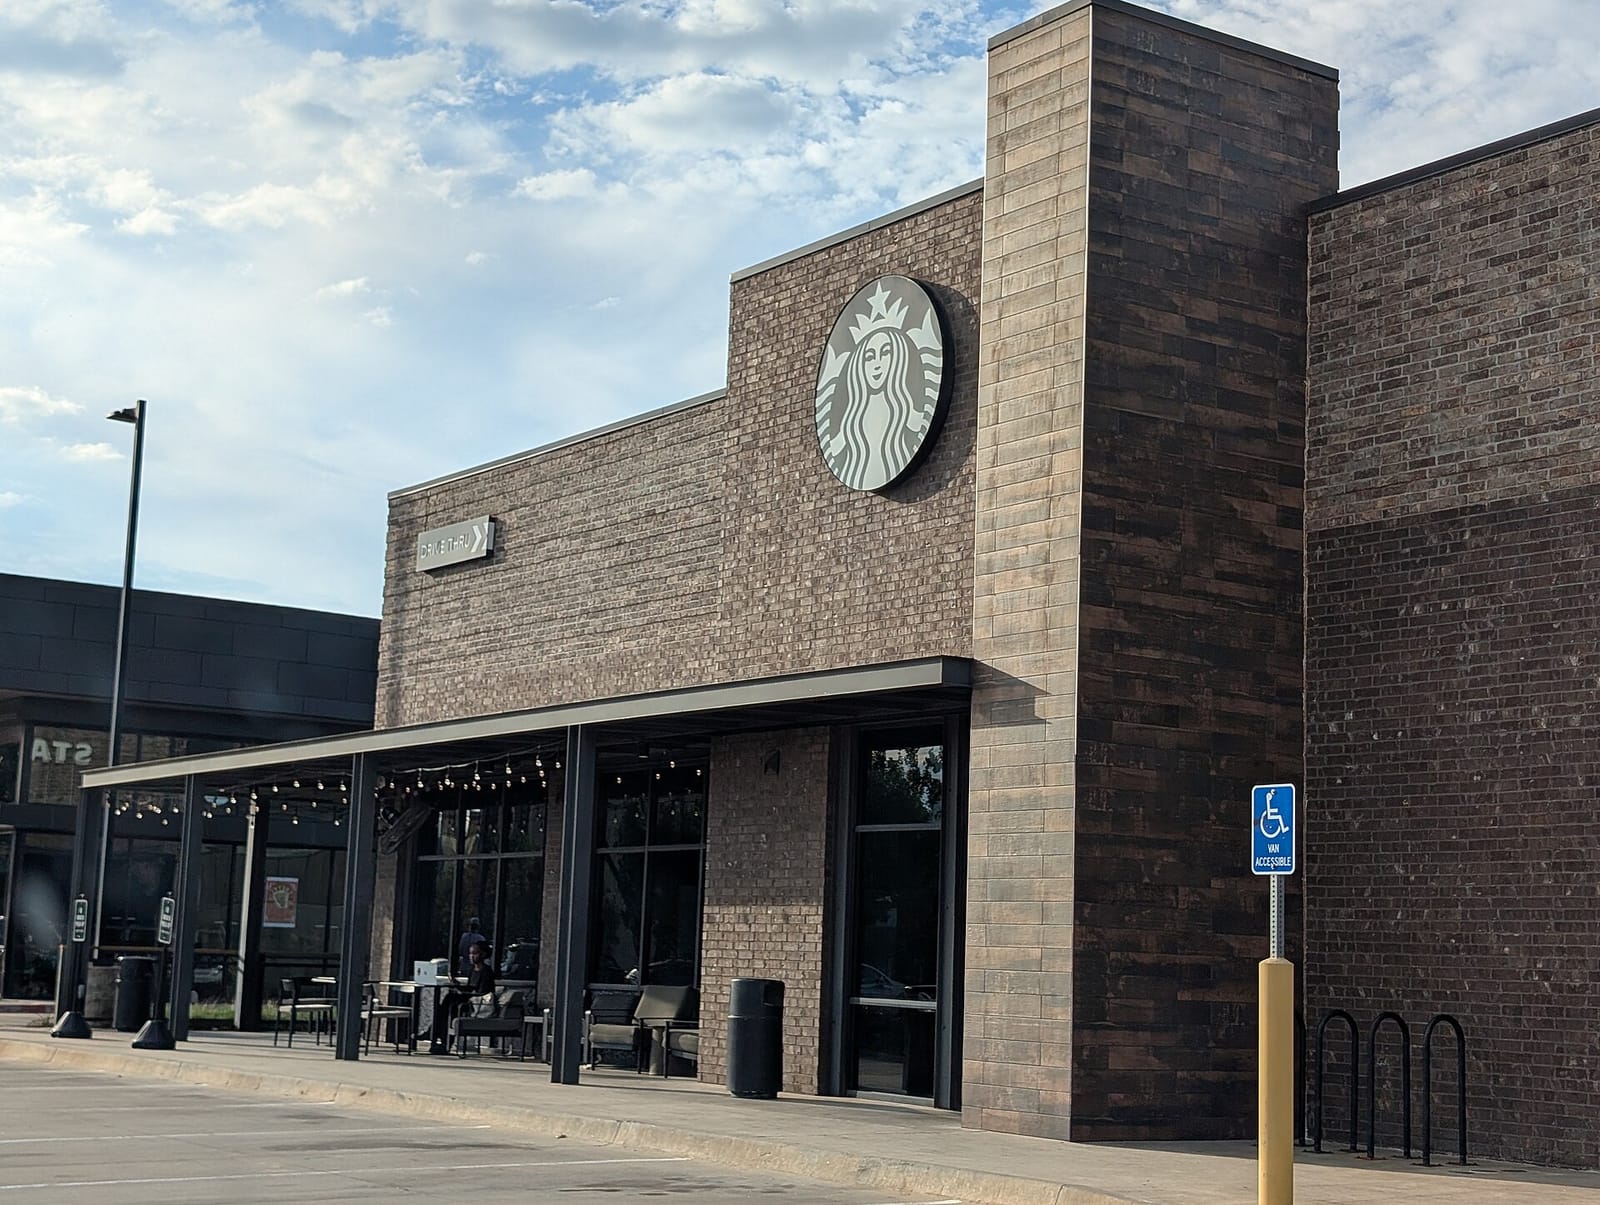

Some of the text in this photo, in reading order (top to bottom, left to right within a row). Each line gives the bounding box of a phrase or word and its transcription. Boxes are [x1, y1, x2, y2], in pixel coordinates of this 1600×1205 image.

[421, 533, 470, 559] DRIVE THRU
[1267, 843, 1280, 853] VAN
[1255, 856, 1292, 867] ACCESSIBLE
